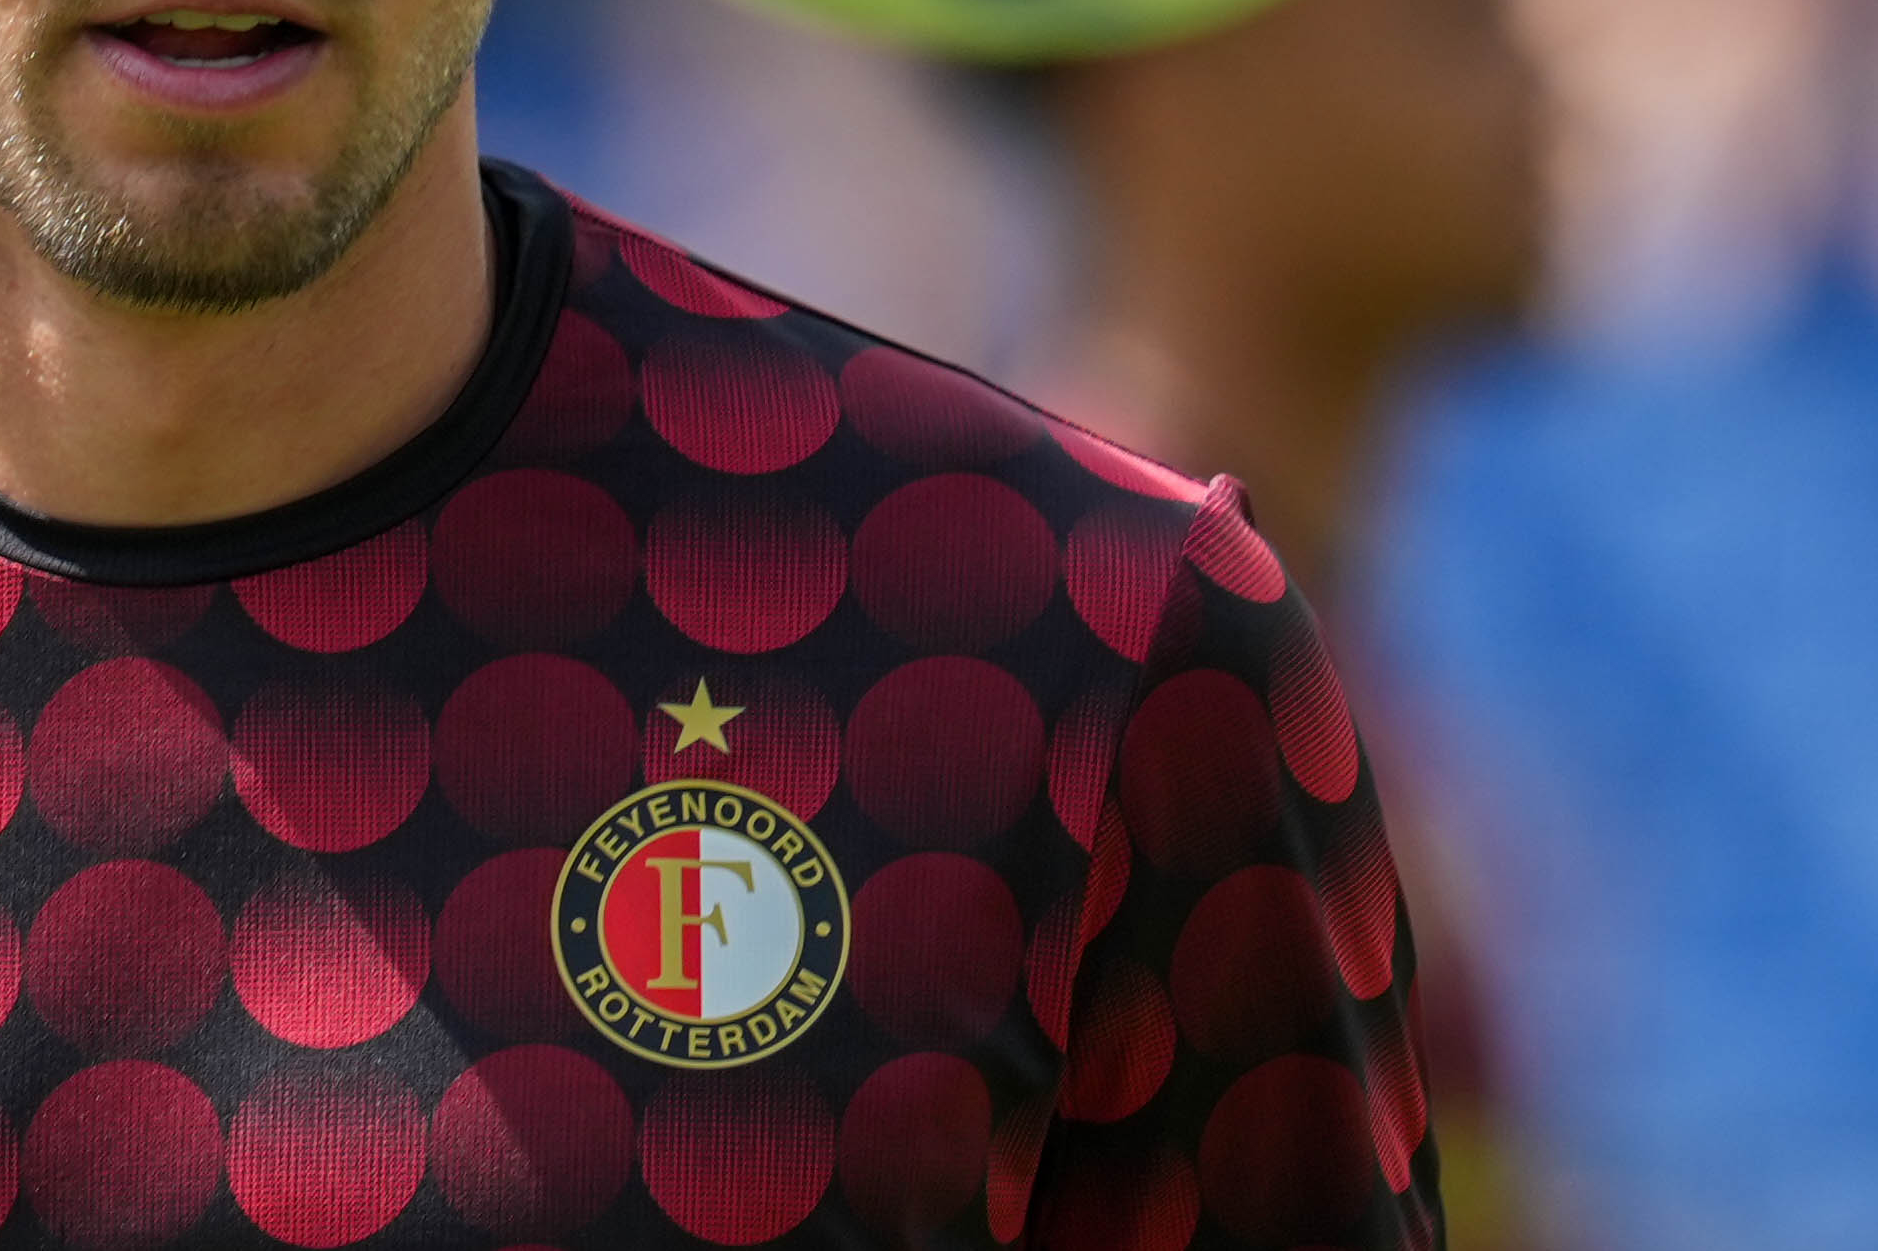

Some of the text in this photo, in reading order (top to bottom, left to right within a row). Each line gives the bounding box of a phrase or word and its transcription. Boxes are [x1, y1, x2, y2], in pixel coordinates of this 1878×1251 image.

[577, 791, 825, 888] FEYENOORD
[645, 857, 755, 990] F
[576, 964, 827, 1059] ROTTERDAM
